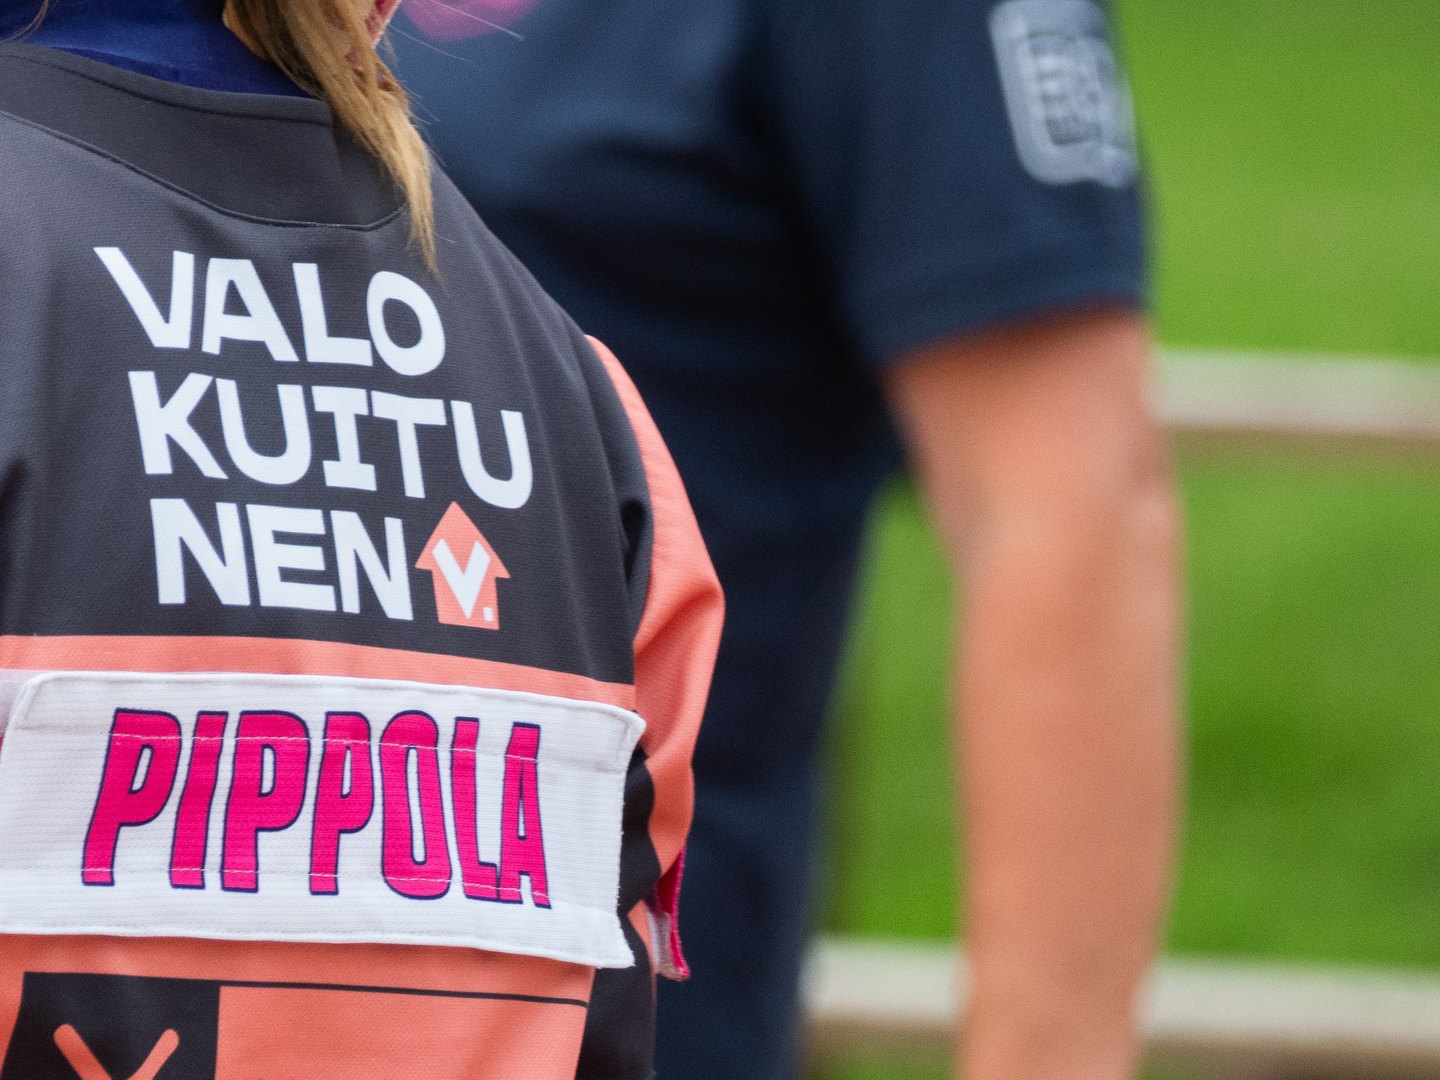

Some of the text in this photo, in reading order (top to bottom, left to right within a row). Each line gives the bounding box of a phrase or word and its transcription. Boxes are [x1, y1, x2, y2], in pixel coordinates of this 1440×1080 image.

[93, 246, 446, 376] VALO
[127, 370, 534, 510] KUITU
[149, 498, 414, 621] NEN
[81, 707, 553, 910] PIPPOLA
